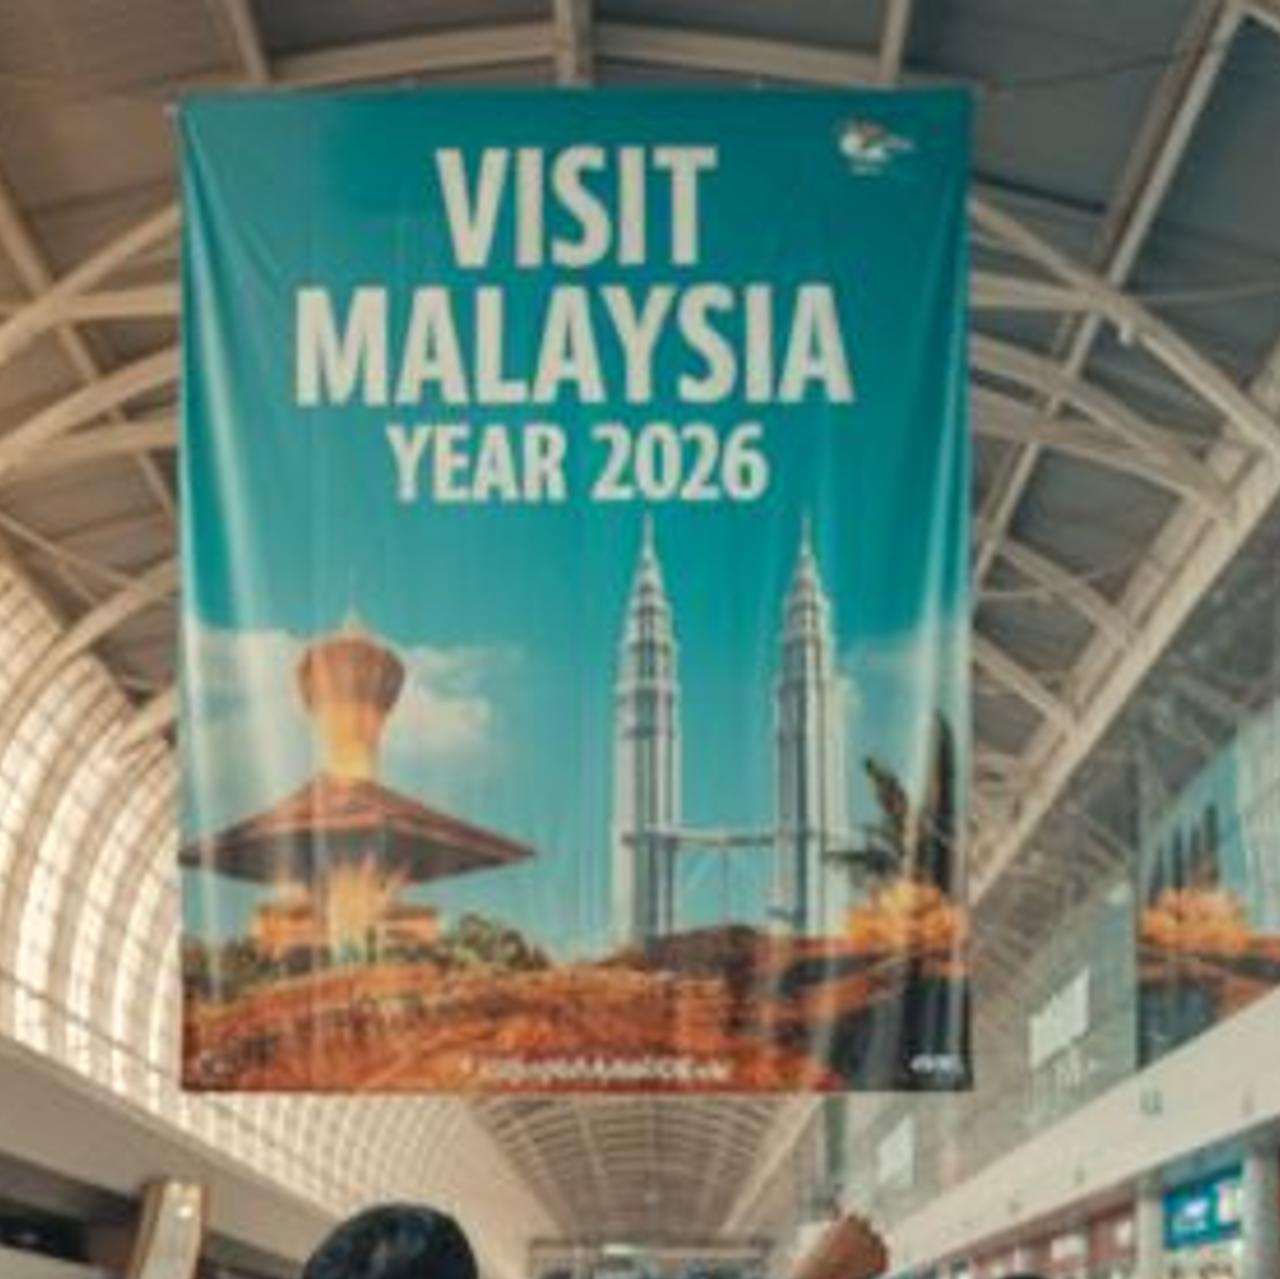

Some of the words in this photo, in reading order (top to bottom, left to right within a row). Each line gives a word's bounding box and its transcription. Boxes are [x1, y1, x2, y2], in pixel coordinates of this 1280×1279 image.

[436, 145, 718, 269] VISIT
[294, 283, 855, 407] MALAYSIA
[385, 421, 567, 502] YEAR
[591, 422, 770, 502] 2026
